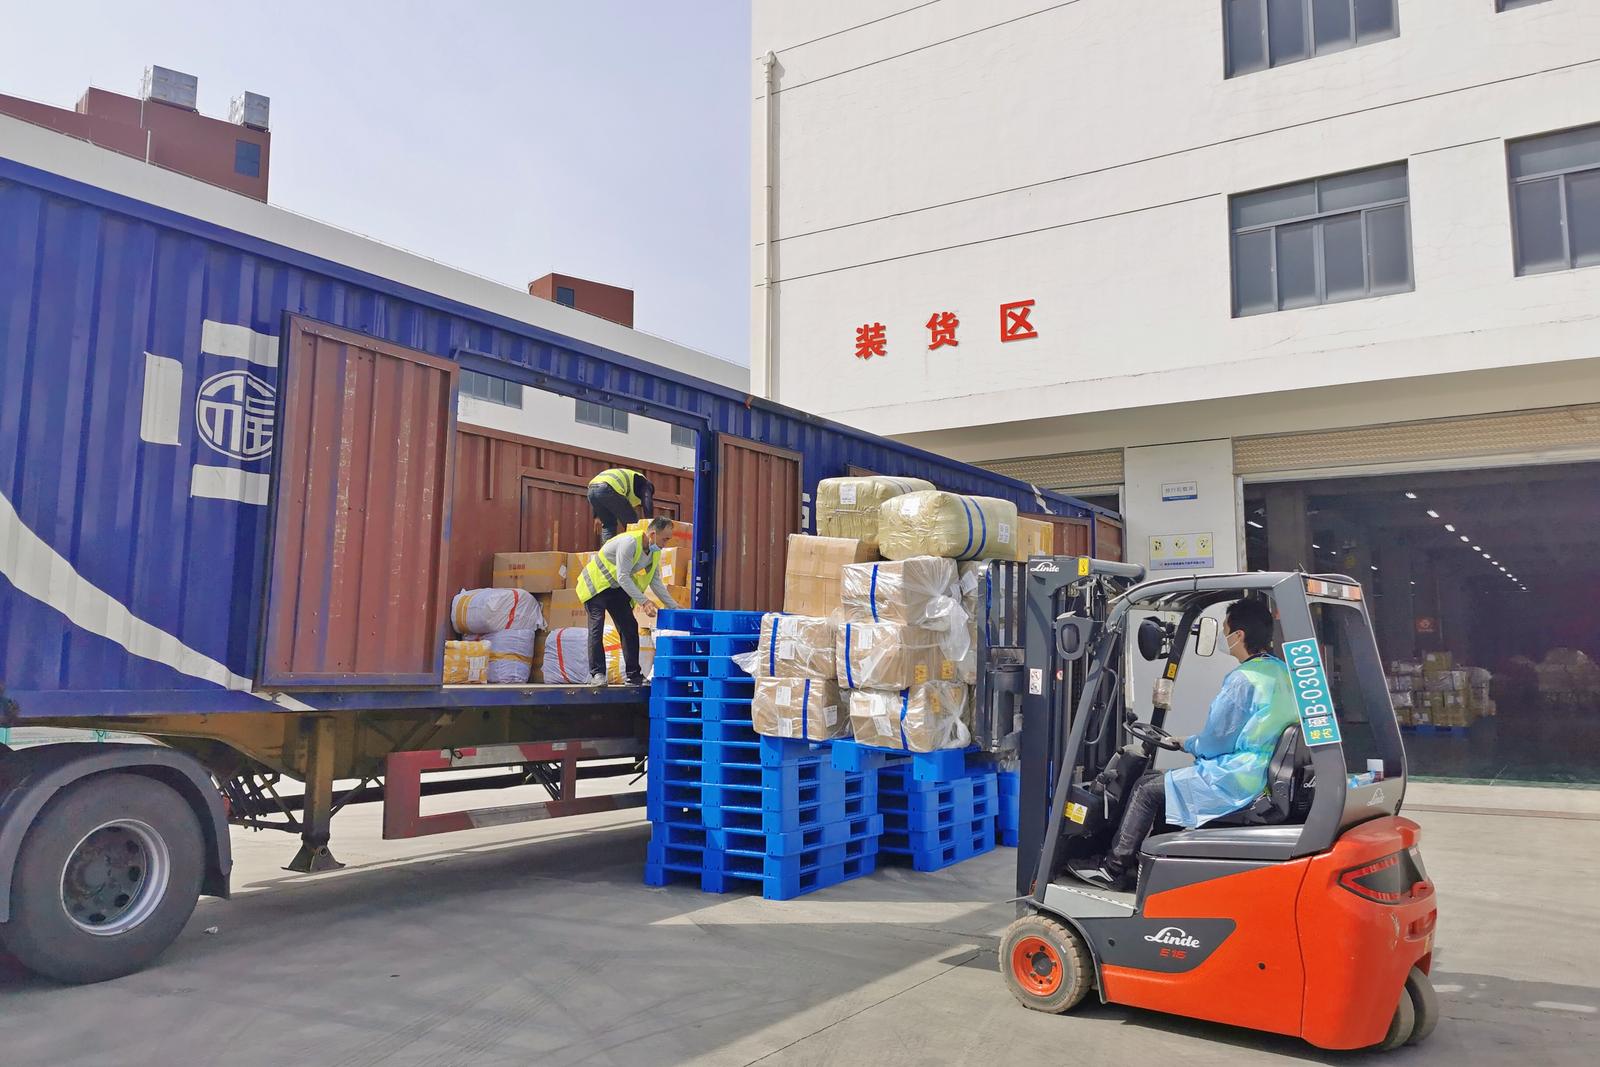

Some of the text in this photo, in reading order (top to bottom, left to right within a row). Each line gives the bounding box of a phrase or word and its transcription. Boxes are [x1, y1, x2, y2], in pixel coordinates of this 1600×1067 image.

[855, 299, 1039, 360] 装货区
[1030, 561, 1060, 573] Linde
[1144, 927, 1200, 948] Linde
